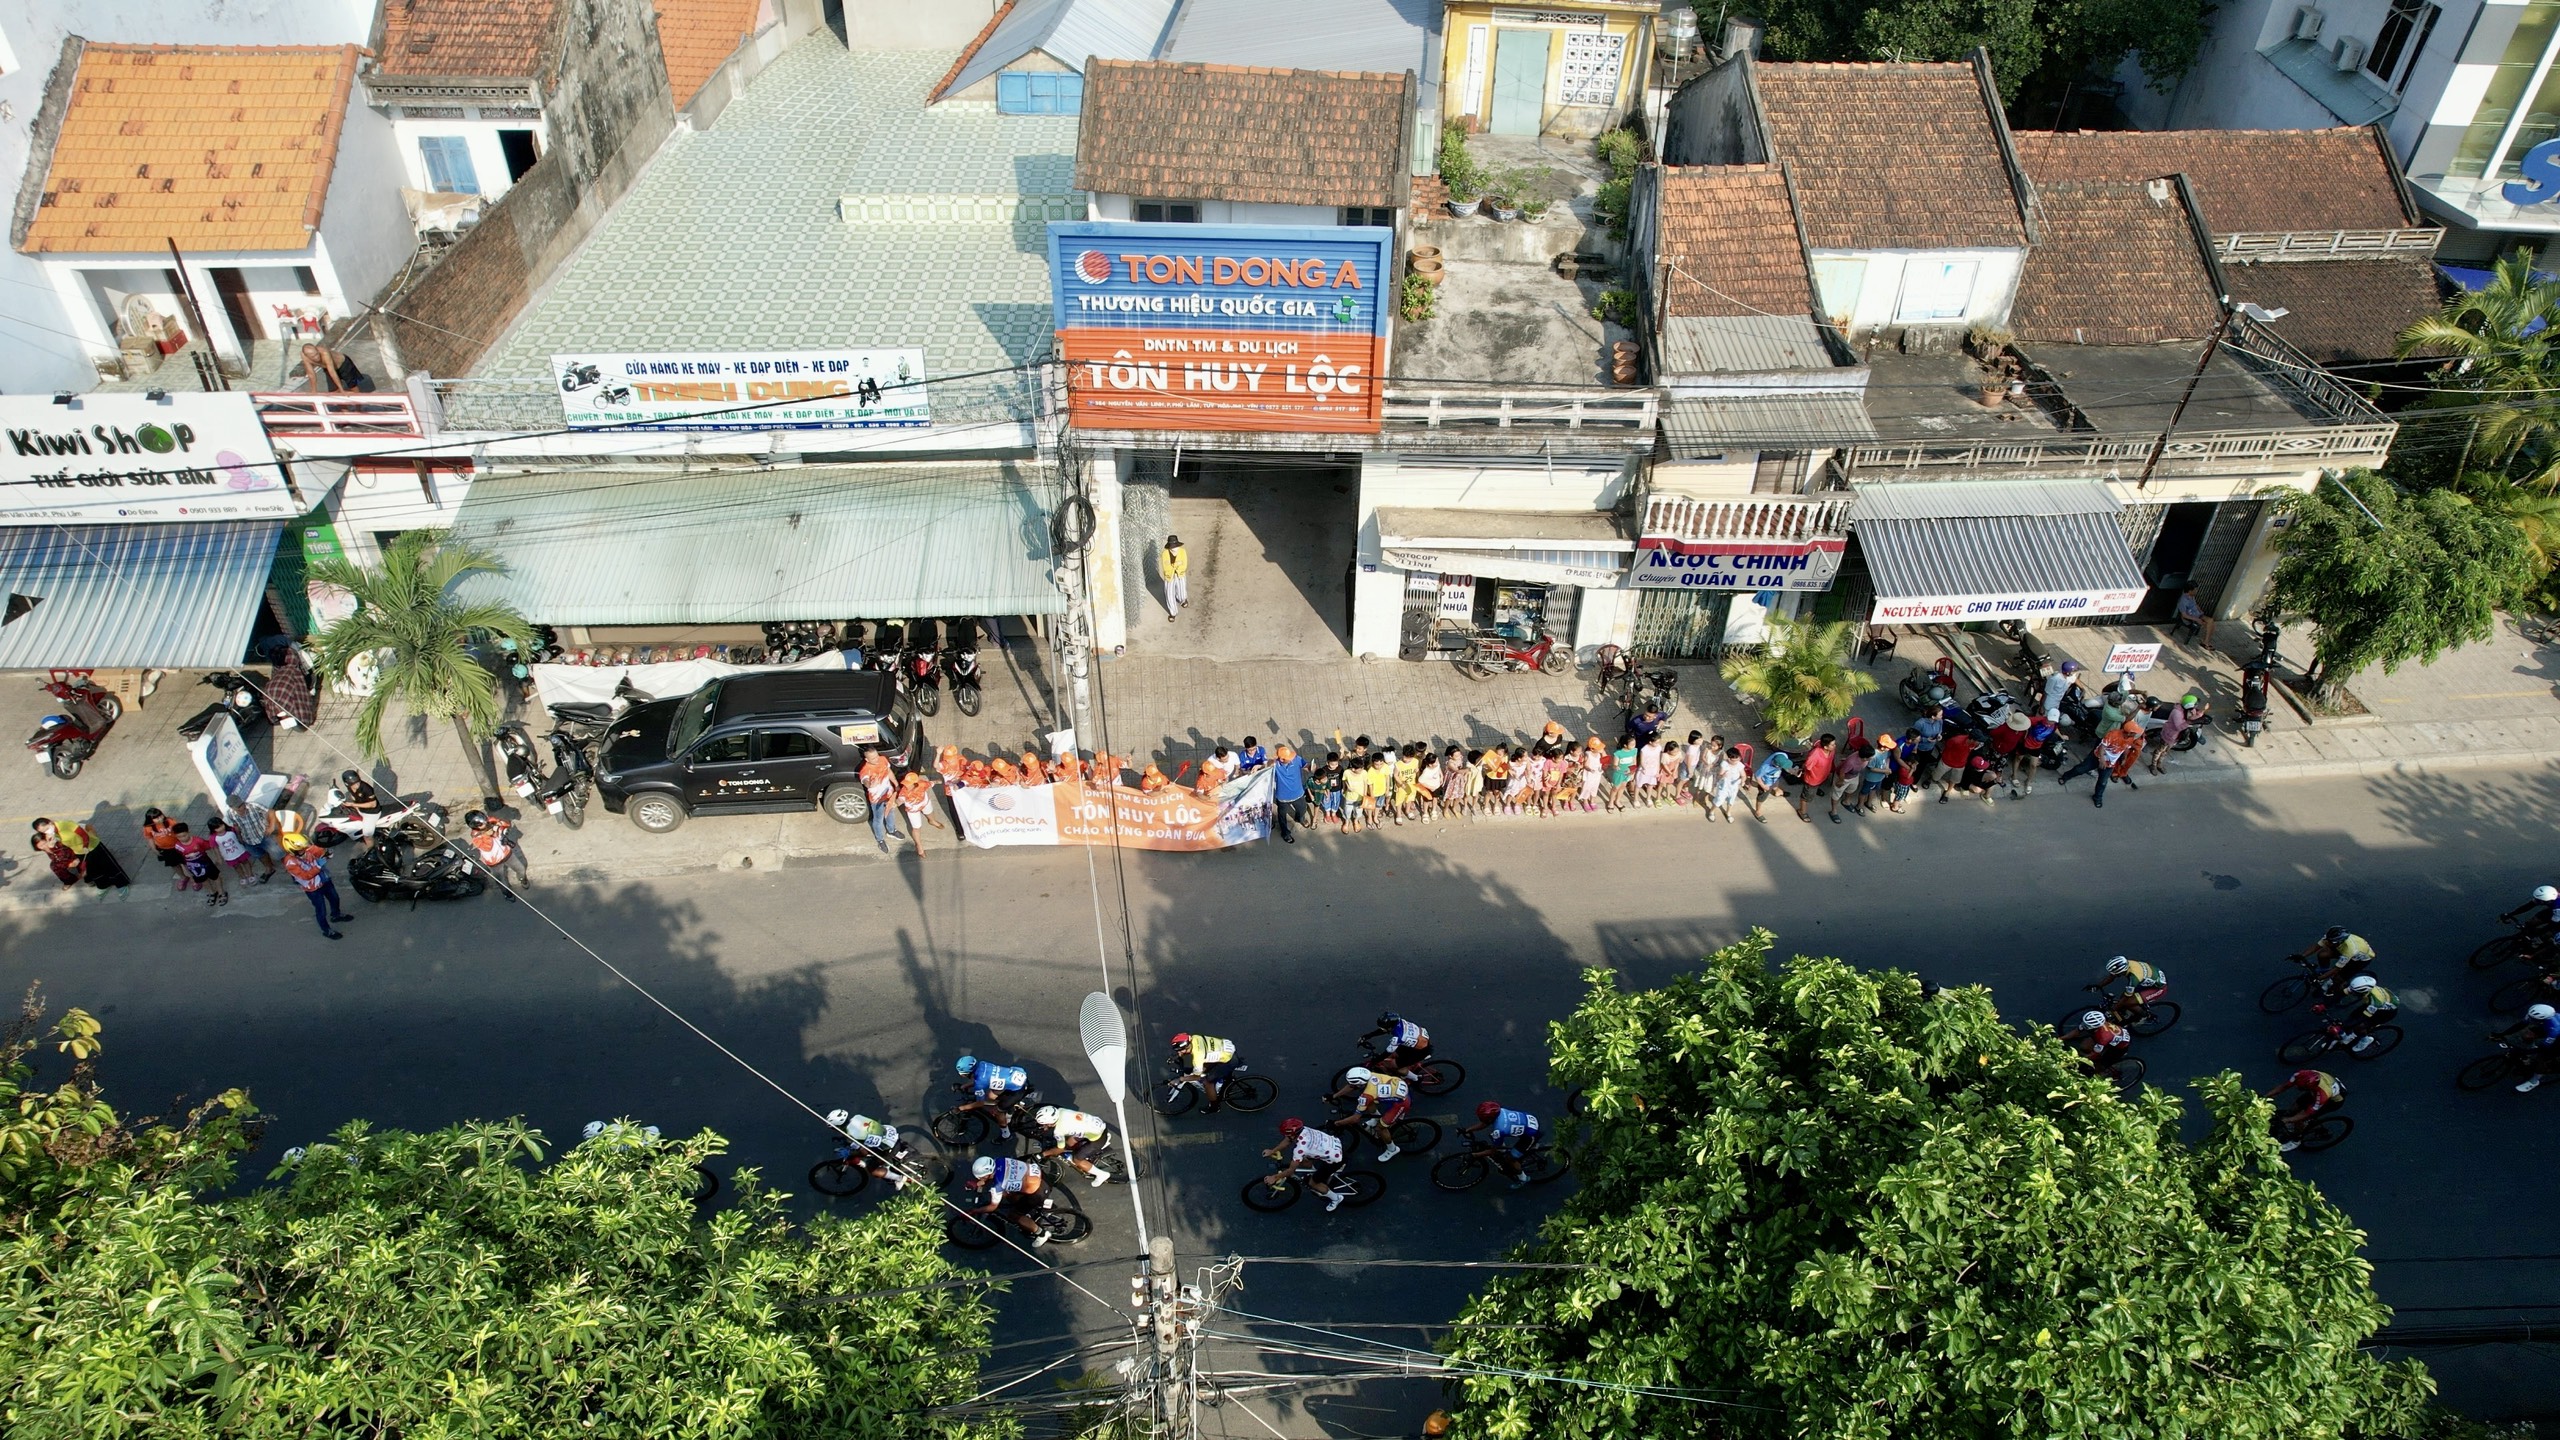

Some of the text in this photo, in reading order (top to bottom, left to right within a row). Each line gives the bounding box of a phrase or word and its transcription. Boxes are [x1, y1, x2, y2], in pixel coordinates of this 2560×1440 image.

[1120, 254, 1362, 290] TON DONG A
[1078, 293, 1316, 318] THƯƠNG HIỆU QUỐC GIA
[1144, 339, 1298, 358] DNTN TM & DU LỊCH
[625, 359, 647, 375] CỬA
[651, 359, 679, 374] HÀNG
[682, 362, 695, 375] XE
[734, 361, 747, 374] XE
[812, 360, 825, 373] XE
[1084, 349, 1361, 402] TÔN HUY LỘC
[604, 412, 624, 420] MUA
[741, 411, 752, 420] XE
[783, 411, 793, 419] XE
[844, 409, 855, 418] XE
[6, 428, 92, 456] Kiwi
[31, 466, 75, 488] THẾ
[77, 467, 124, 488] GIỚI
[126, 465, 172, 486] SỮA
[1393, 553, 1439, 561] HOTOCOPY
[1650, 551, 1722, 571] NGỌC
[1681, 570, 1737, 588] QUẤN
[1747, 575, 1784, 587] LOA
[1882, 602, 1929, 617] NGUYỄN
[1967, 602, 1992, 613] CHO
[1995, 598, 2025, 612] THUÊ
[2027, 598, 2056, 610] GIÀN
[2058, 597, 2088, 609] GIÁO
[2110, 654, 2154, 663] PHOTOCOPY
[1117, 793, 1131, 801] TM
[1142, 798, 1158, 806] DU
[1160, 792, 1184, 805] LỊCH
[994, 816, 1035, 825] DONG
[1071, 800, 1202, 827] TÔN HUY LỘC
[1064, 825, 1100, 835] CHÀO
[992, 1080, 1004, 1089] 72
[1379, 1086, 1390, 1095] 41
[865, 1136, 880, 1147] 33
